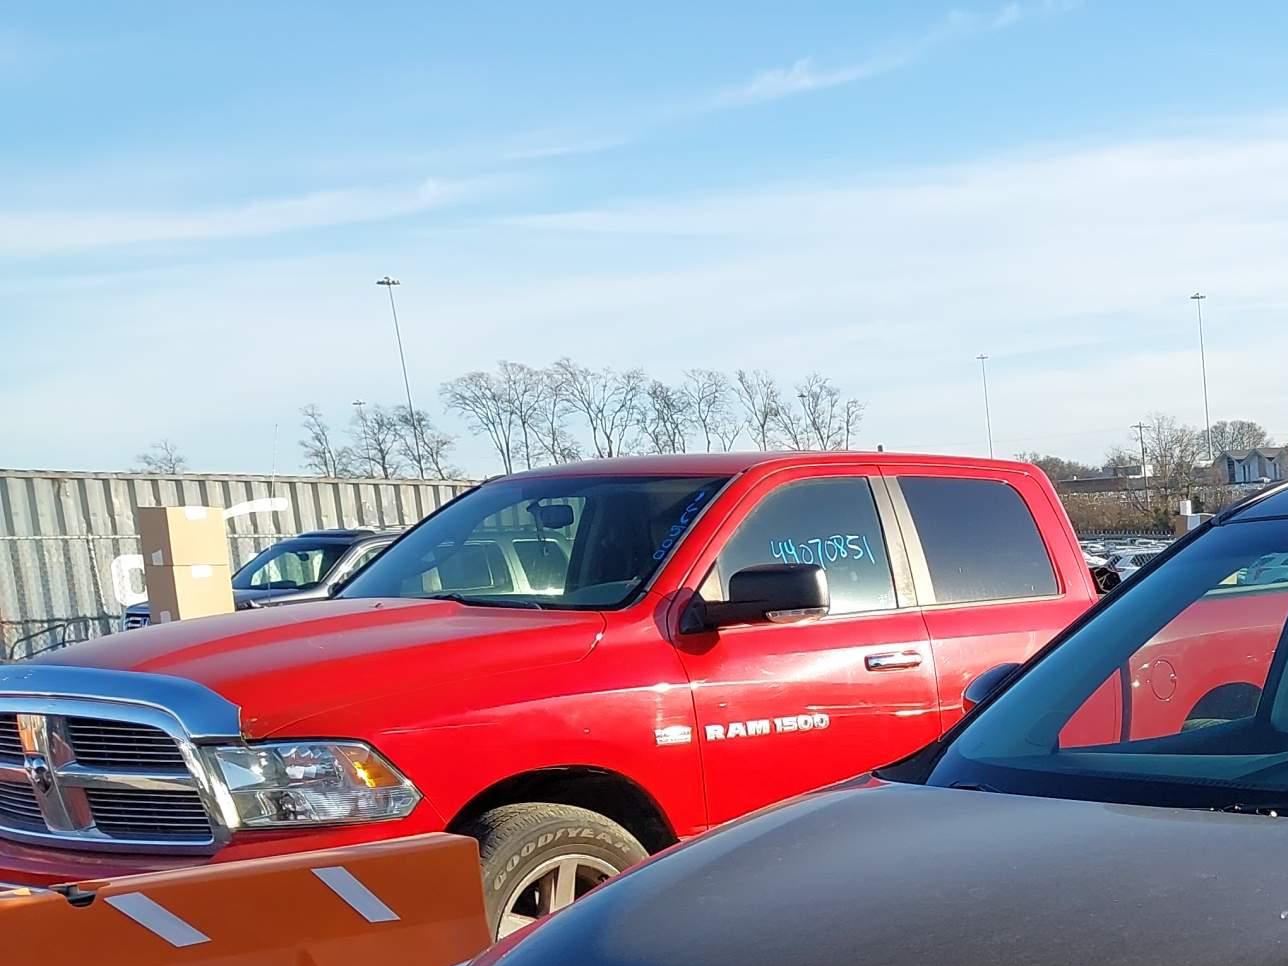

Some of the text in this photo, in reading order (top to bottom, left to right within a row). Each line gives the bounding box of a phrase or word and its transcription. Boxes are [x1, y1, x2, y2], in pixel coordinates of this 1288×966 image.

[770, 535, 876, 571] 44070851
[705, 719, 771, 742] RAM
[773, 713, 831, 734] 1500
